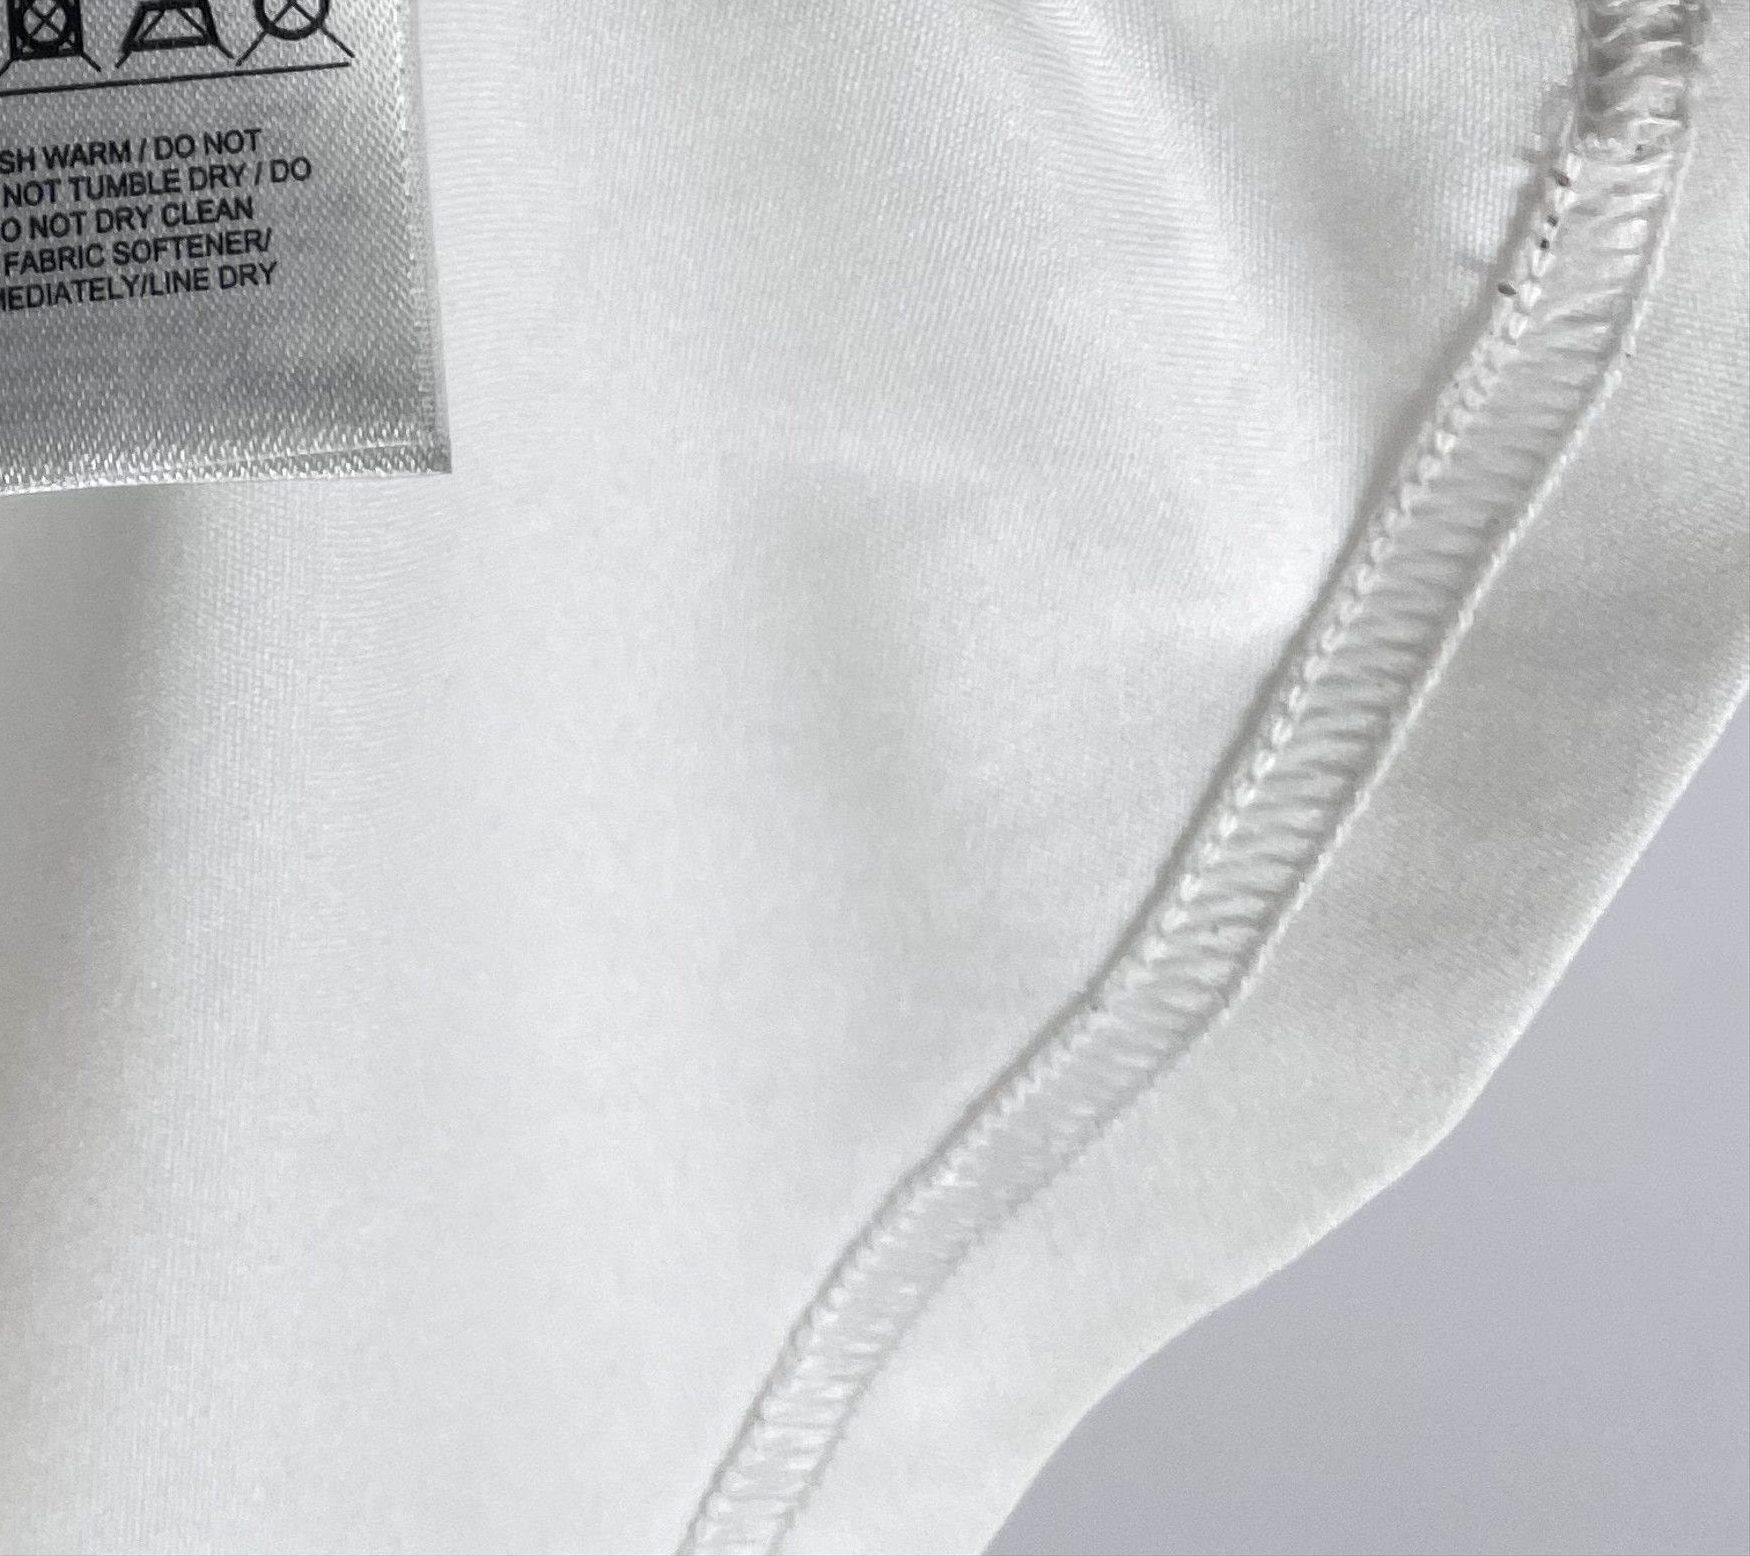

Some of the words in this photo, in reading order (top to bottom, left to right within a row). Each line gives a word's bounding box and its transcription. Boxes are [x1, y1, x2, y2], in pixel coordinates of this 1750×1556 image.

[44, 140, 131, 169] WARM
[139, 139, 147, 162] /
[154, 134, 195, 160] DO
[204, 129, 262, 155] NOT
[3, 178, 61, 207] NOT
[69, 169, 180, 201] TUMBLE
[189, 163, 246, 191] DRY
[254, 161, 262, 185] /
[271, 157, 311, 182] DO
[30, 211, 86, 239] NOT
[96, 205, 152, 233] DRY
[162, 196, 253, 227] CLEAN
[4, 243, 105, 277] FABRIC
[113, 228, 272, 266] SOFTENER/
[219, 261, 277, 289] DRY
